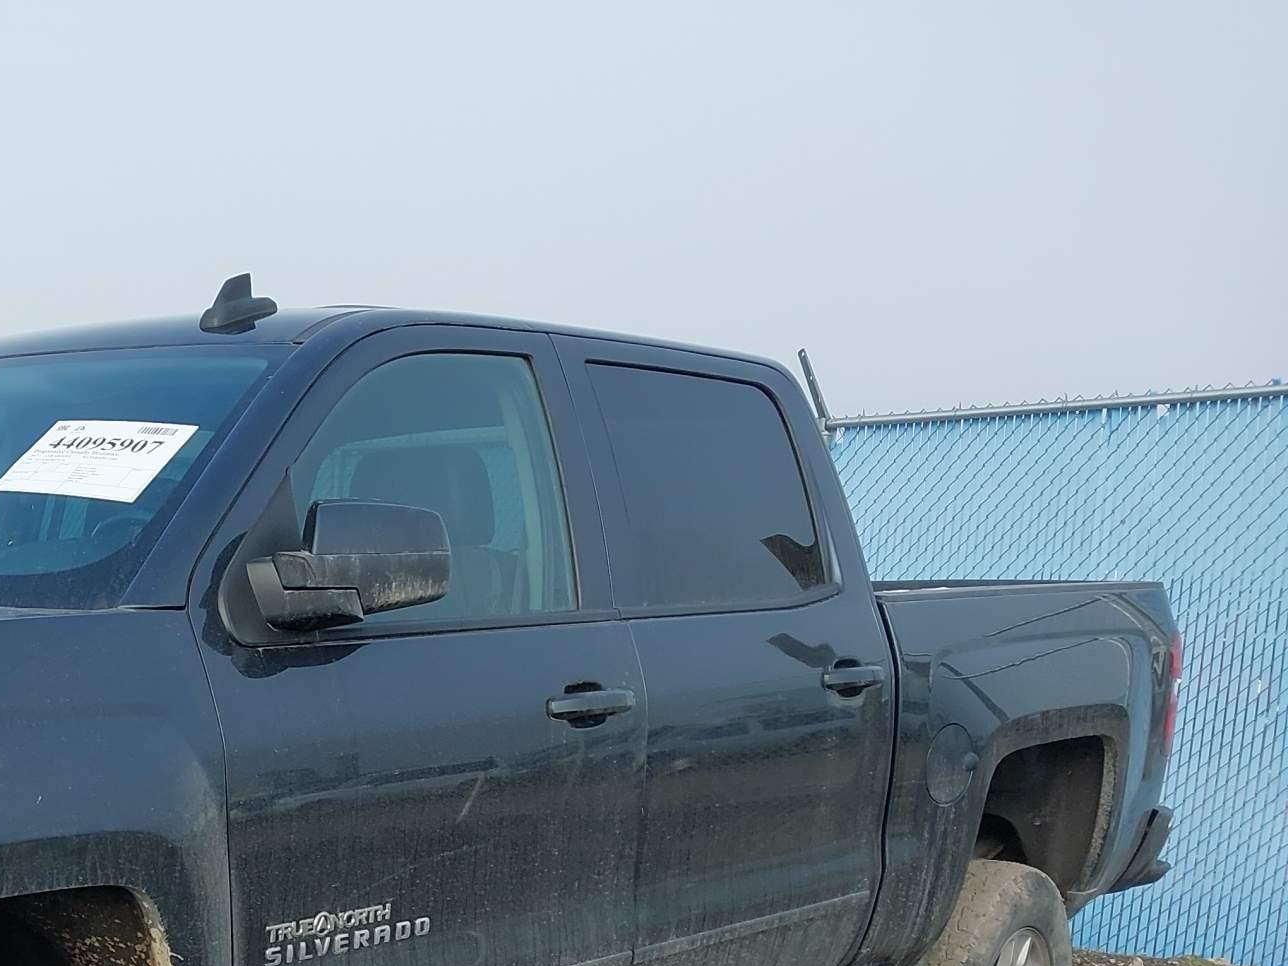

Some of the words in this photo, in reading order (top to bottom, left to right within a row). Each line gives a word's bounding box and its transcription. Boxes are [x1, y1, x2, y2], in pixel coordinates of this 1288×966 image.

[49, 436, 165, 454] 44095907
[265, 918, 315, 943] TRUE
[331, 903, 392, 929] NORTH
